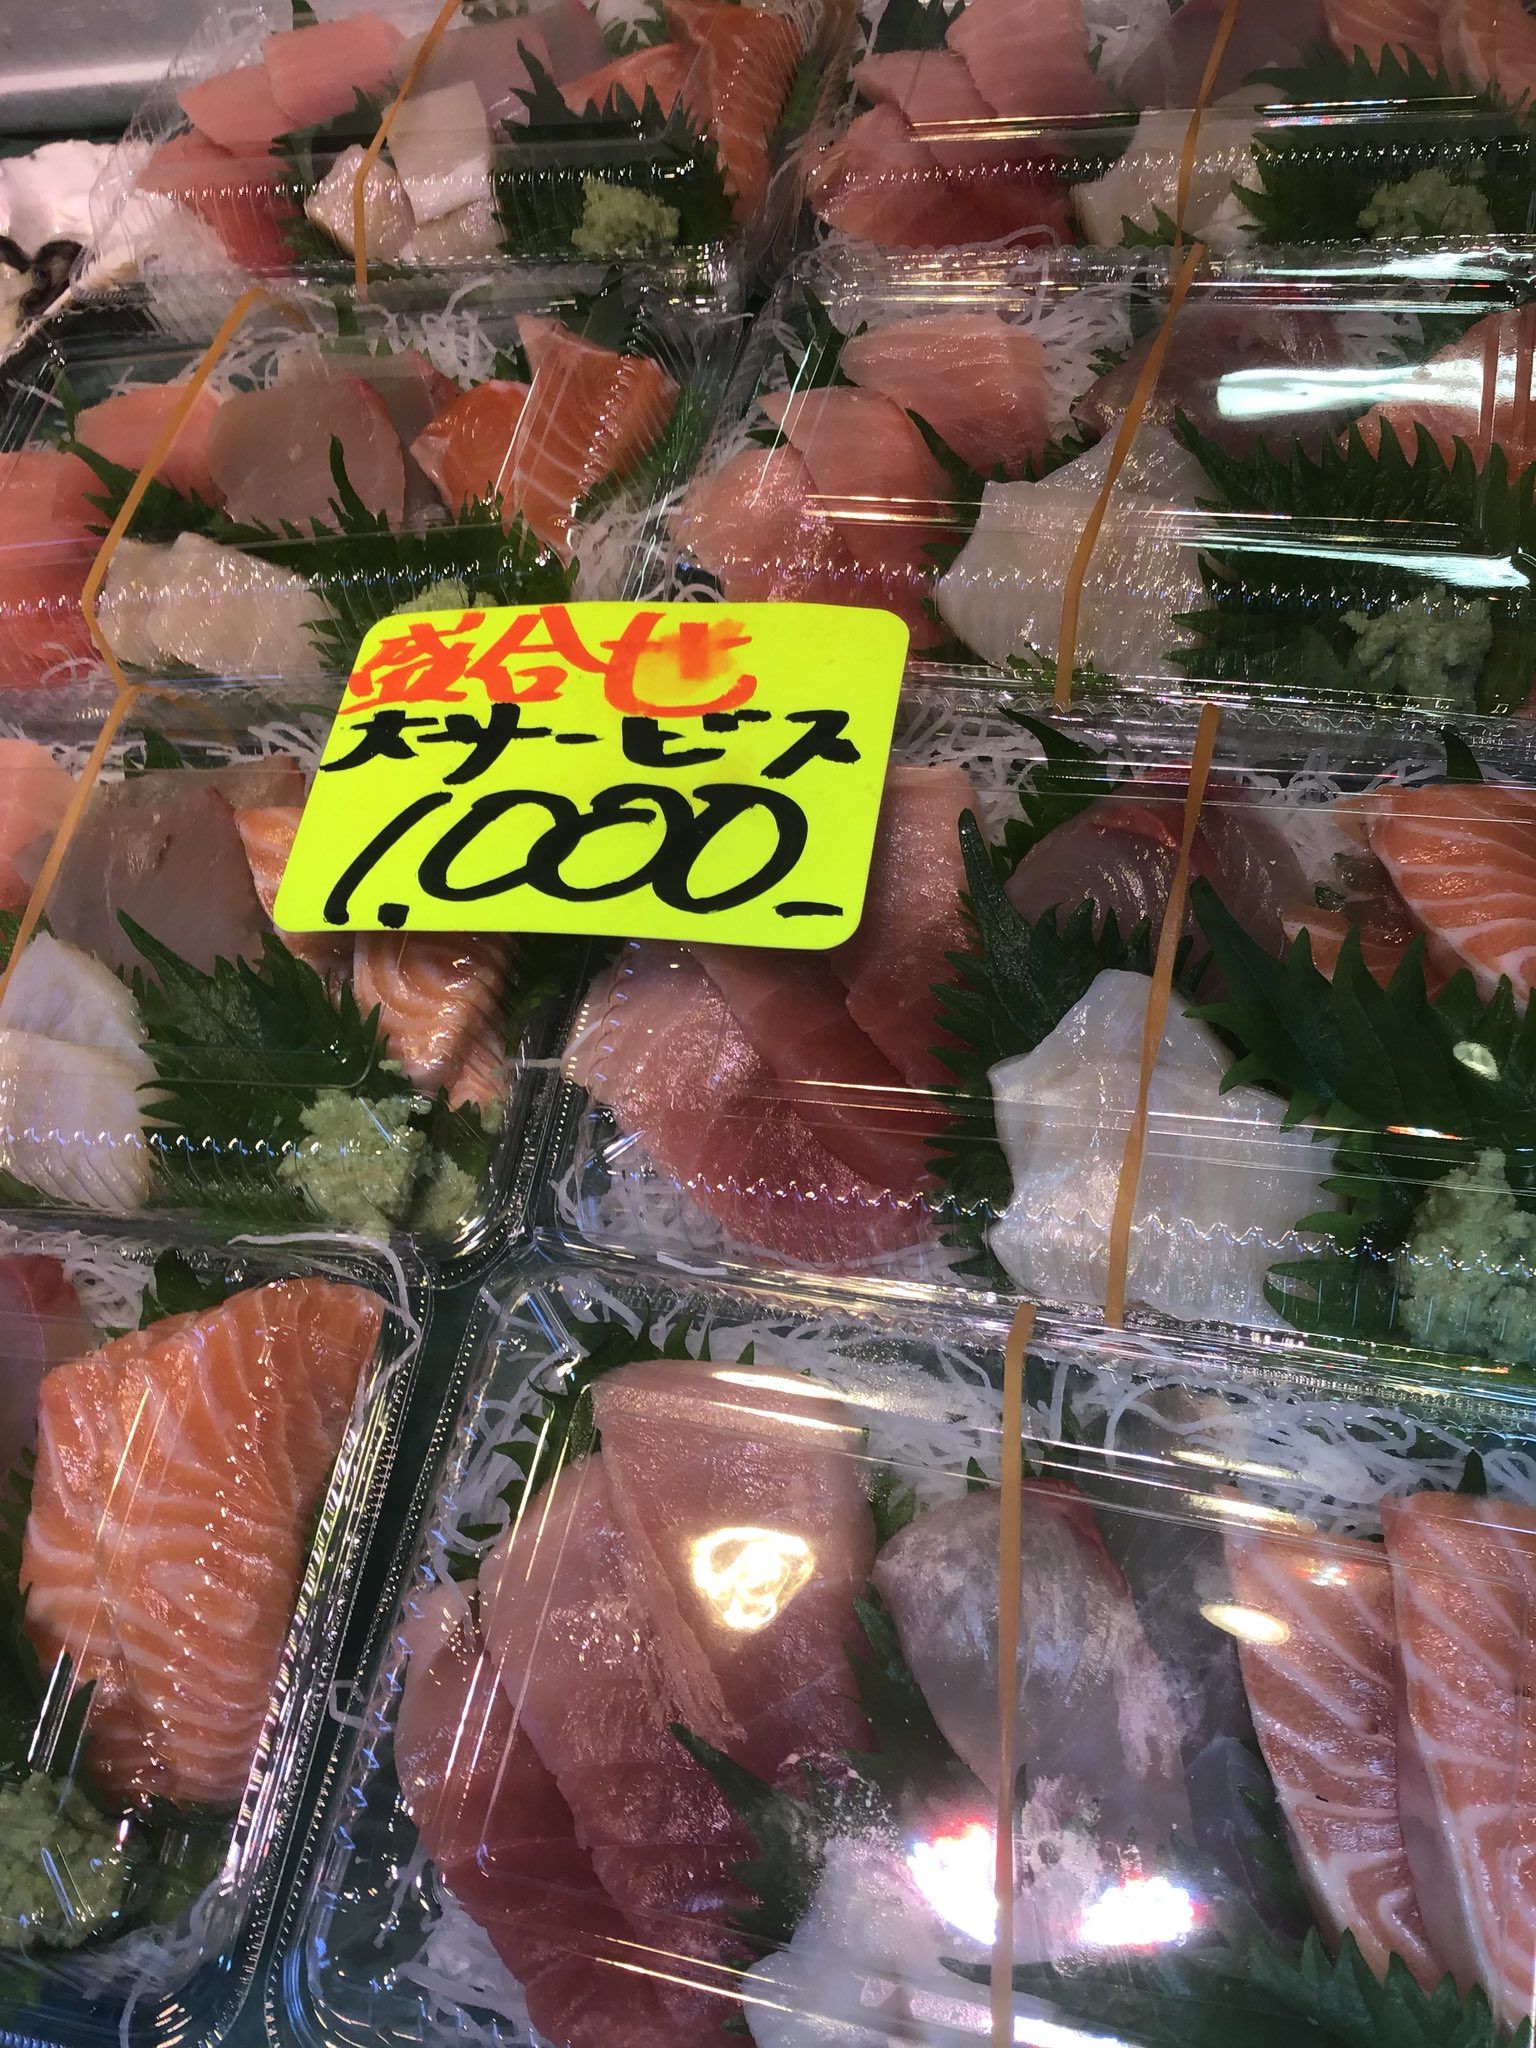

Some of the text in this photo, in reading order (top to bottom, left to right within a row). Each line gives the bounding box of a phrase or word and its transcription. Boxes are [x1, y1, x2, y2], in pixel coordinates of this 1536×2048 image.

[320, 703, 861, 785] 大サービス
